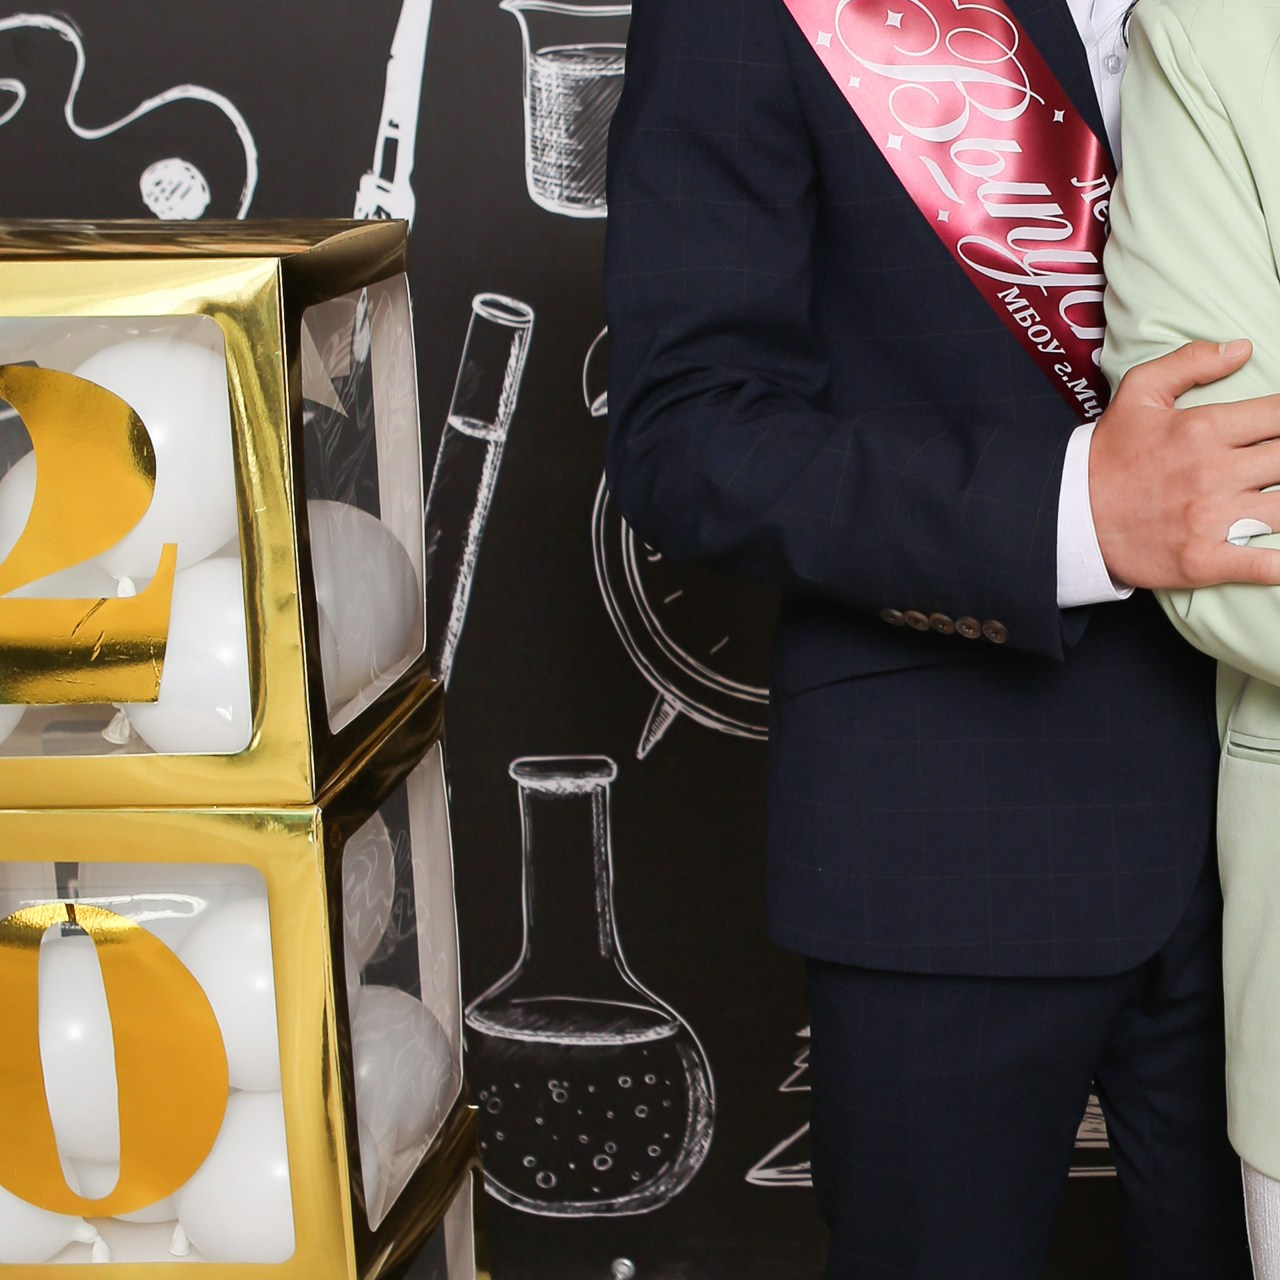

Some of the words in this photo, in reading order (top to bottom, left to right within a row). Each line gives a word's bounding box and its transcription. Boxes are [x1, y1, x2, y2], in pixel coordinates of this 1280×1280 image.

[996, 285, 1066, 355] МБОУ
[1053, 361, 1104, 422] г.Мц
[0, 362, 179, 705] 2
[0, 901, 230, 1219] 0
